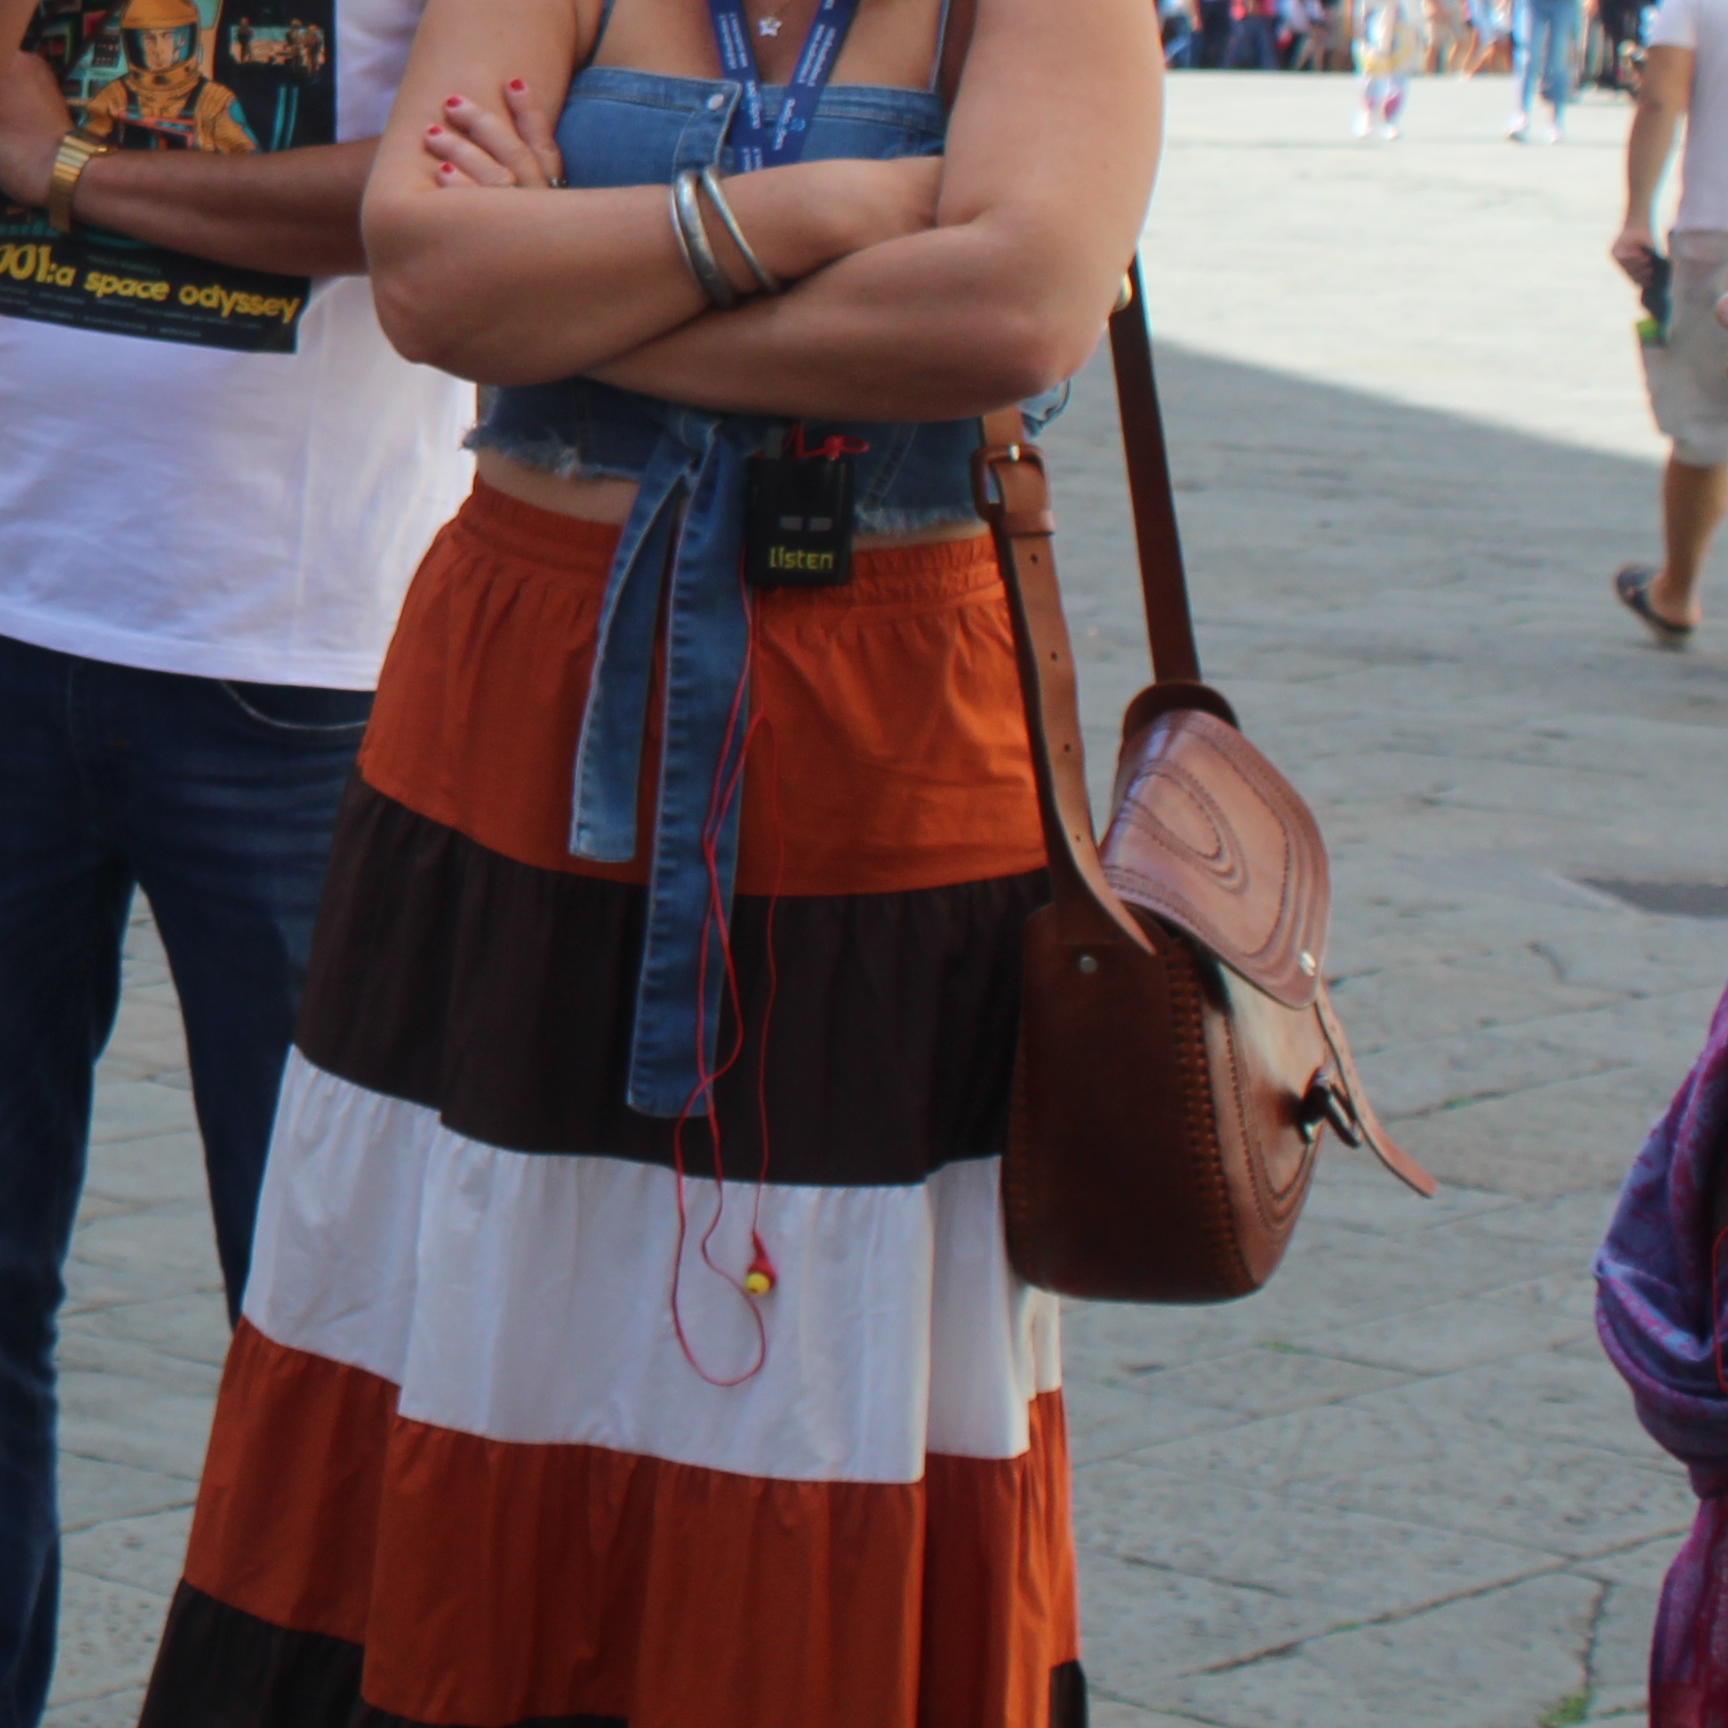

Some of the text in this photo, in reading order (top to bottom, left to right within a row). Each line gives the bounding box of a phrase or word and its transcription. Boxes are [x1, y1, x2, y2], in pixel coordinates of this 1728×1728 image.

[85, 271, 171, 302] space
[178, 284, 301, 325] odyssey
[769, 546, 833, 570] listen
